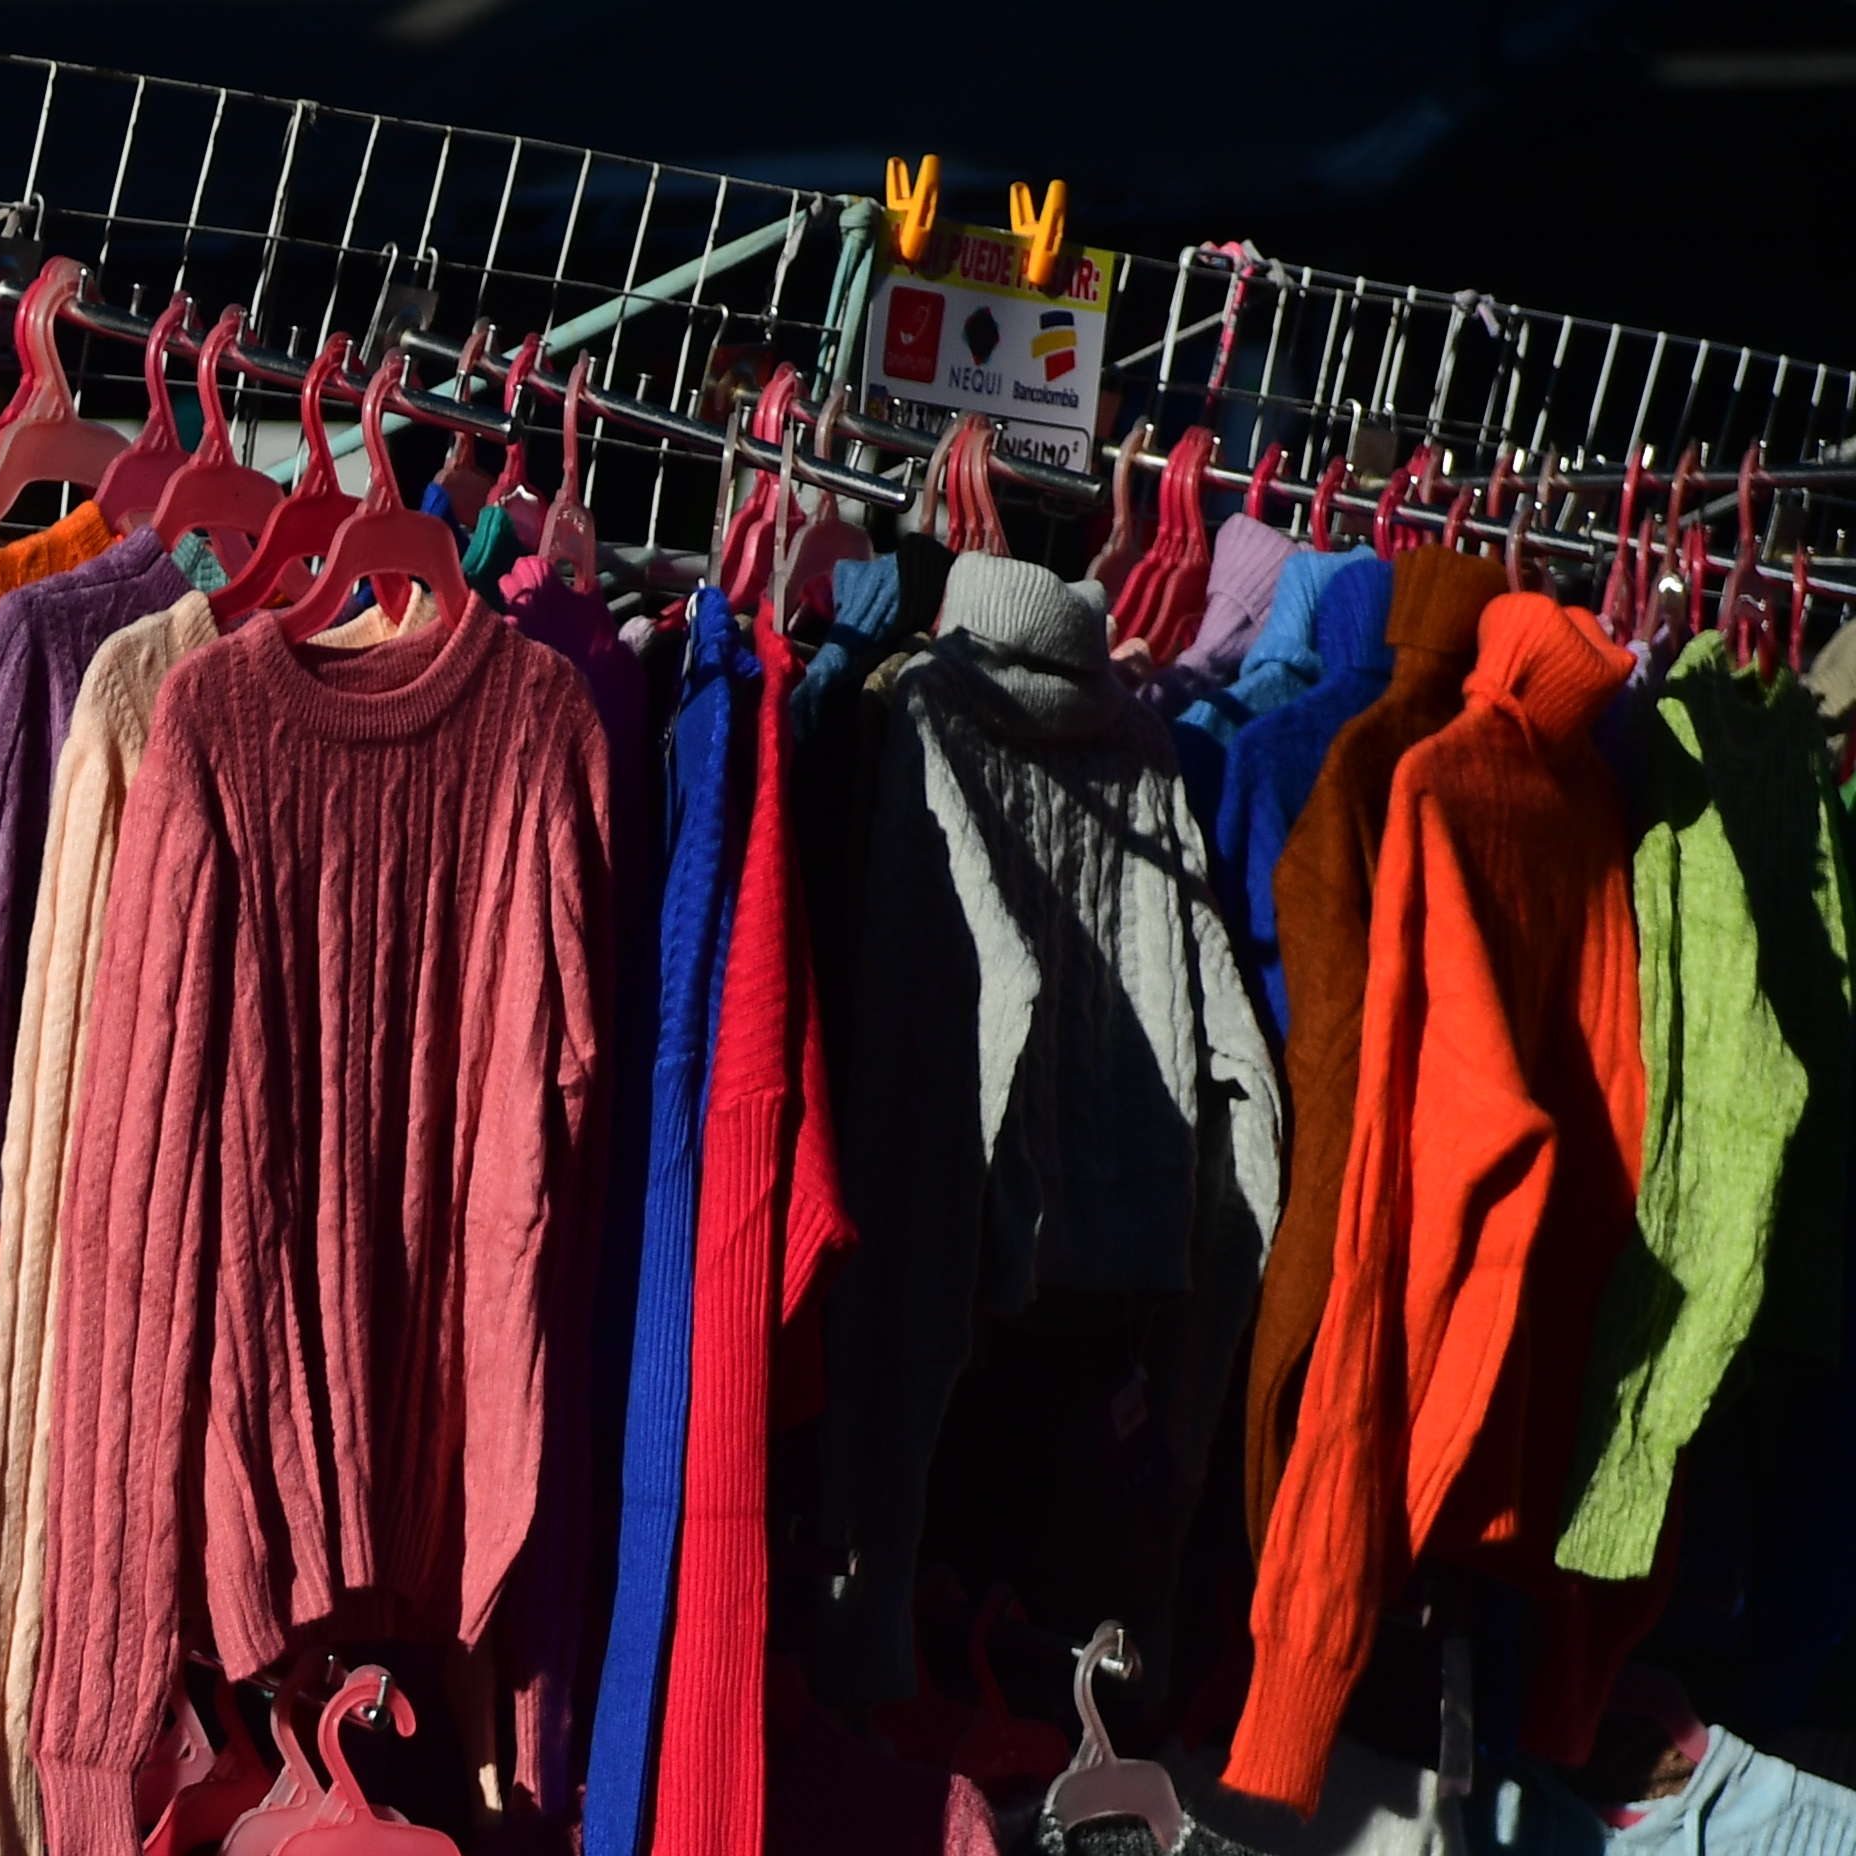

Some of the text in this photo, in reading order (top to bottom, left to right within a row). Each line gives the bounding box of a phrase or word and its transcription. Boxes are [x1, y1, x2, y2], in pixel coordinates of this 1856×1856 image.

[945, 231, 1015, 286] PUEDE
[949, 365, 1002, 395] NEQUI
[1013, 381, 1078, 408] Bancolombia
